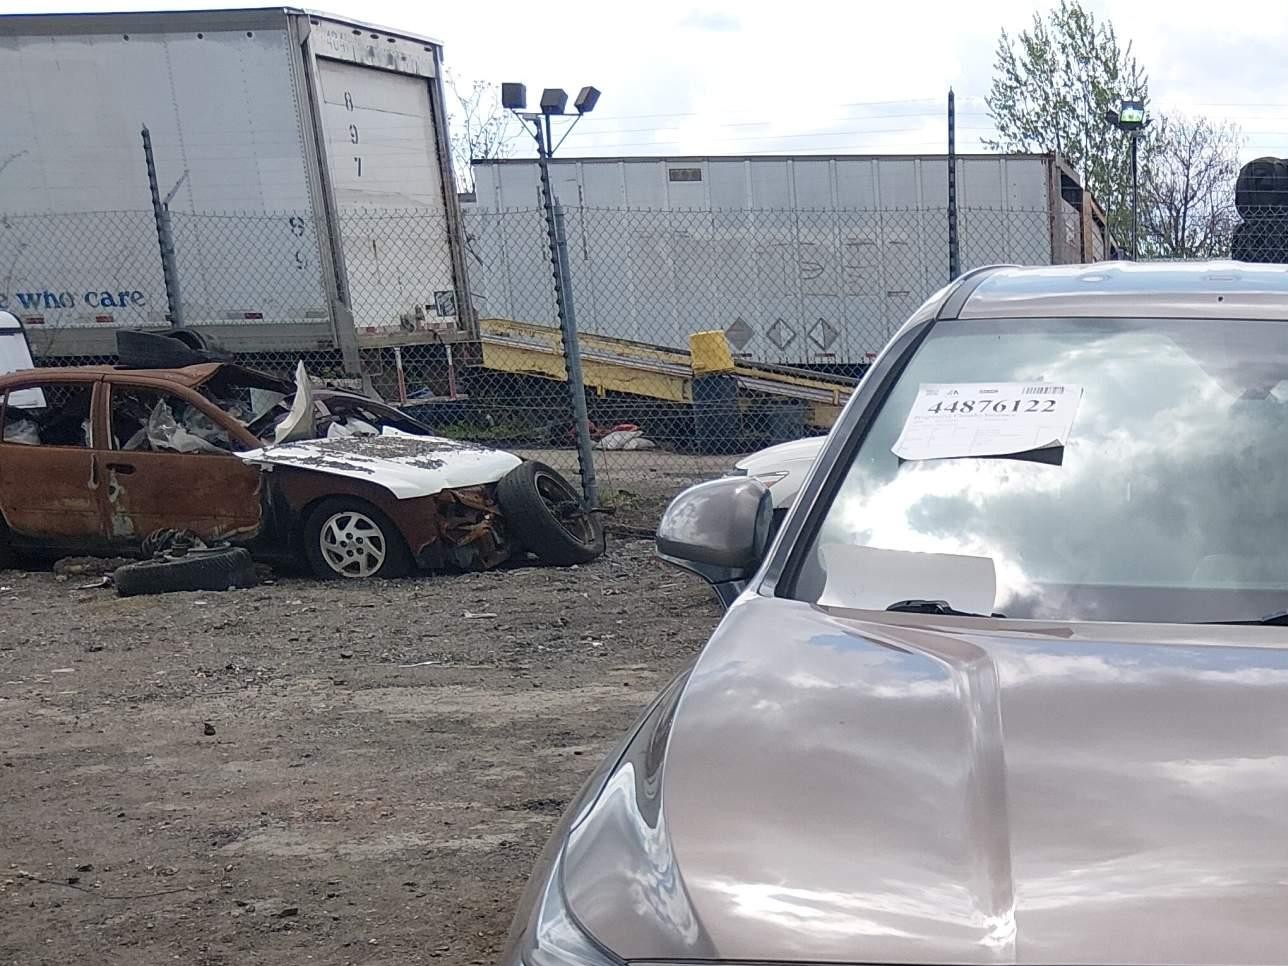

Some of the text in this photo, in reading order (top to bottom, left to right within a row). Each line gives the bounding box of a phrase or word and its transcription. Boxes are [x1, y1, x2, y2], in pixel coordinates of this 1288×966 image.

[16, 287, 75, 310] who
[84, 289, 146, 309] care
[927, 399, 1057, 414] 44876122
